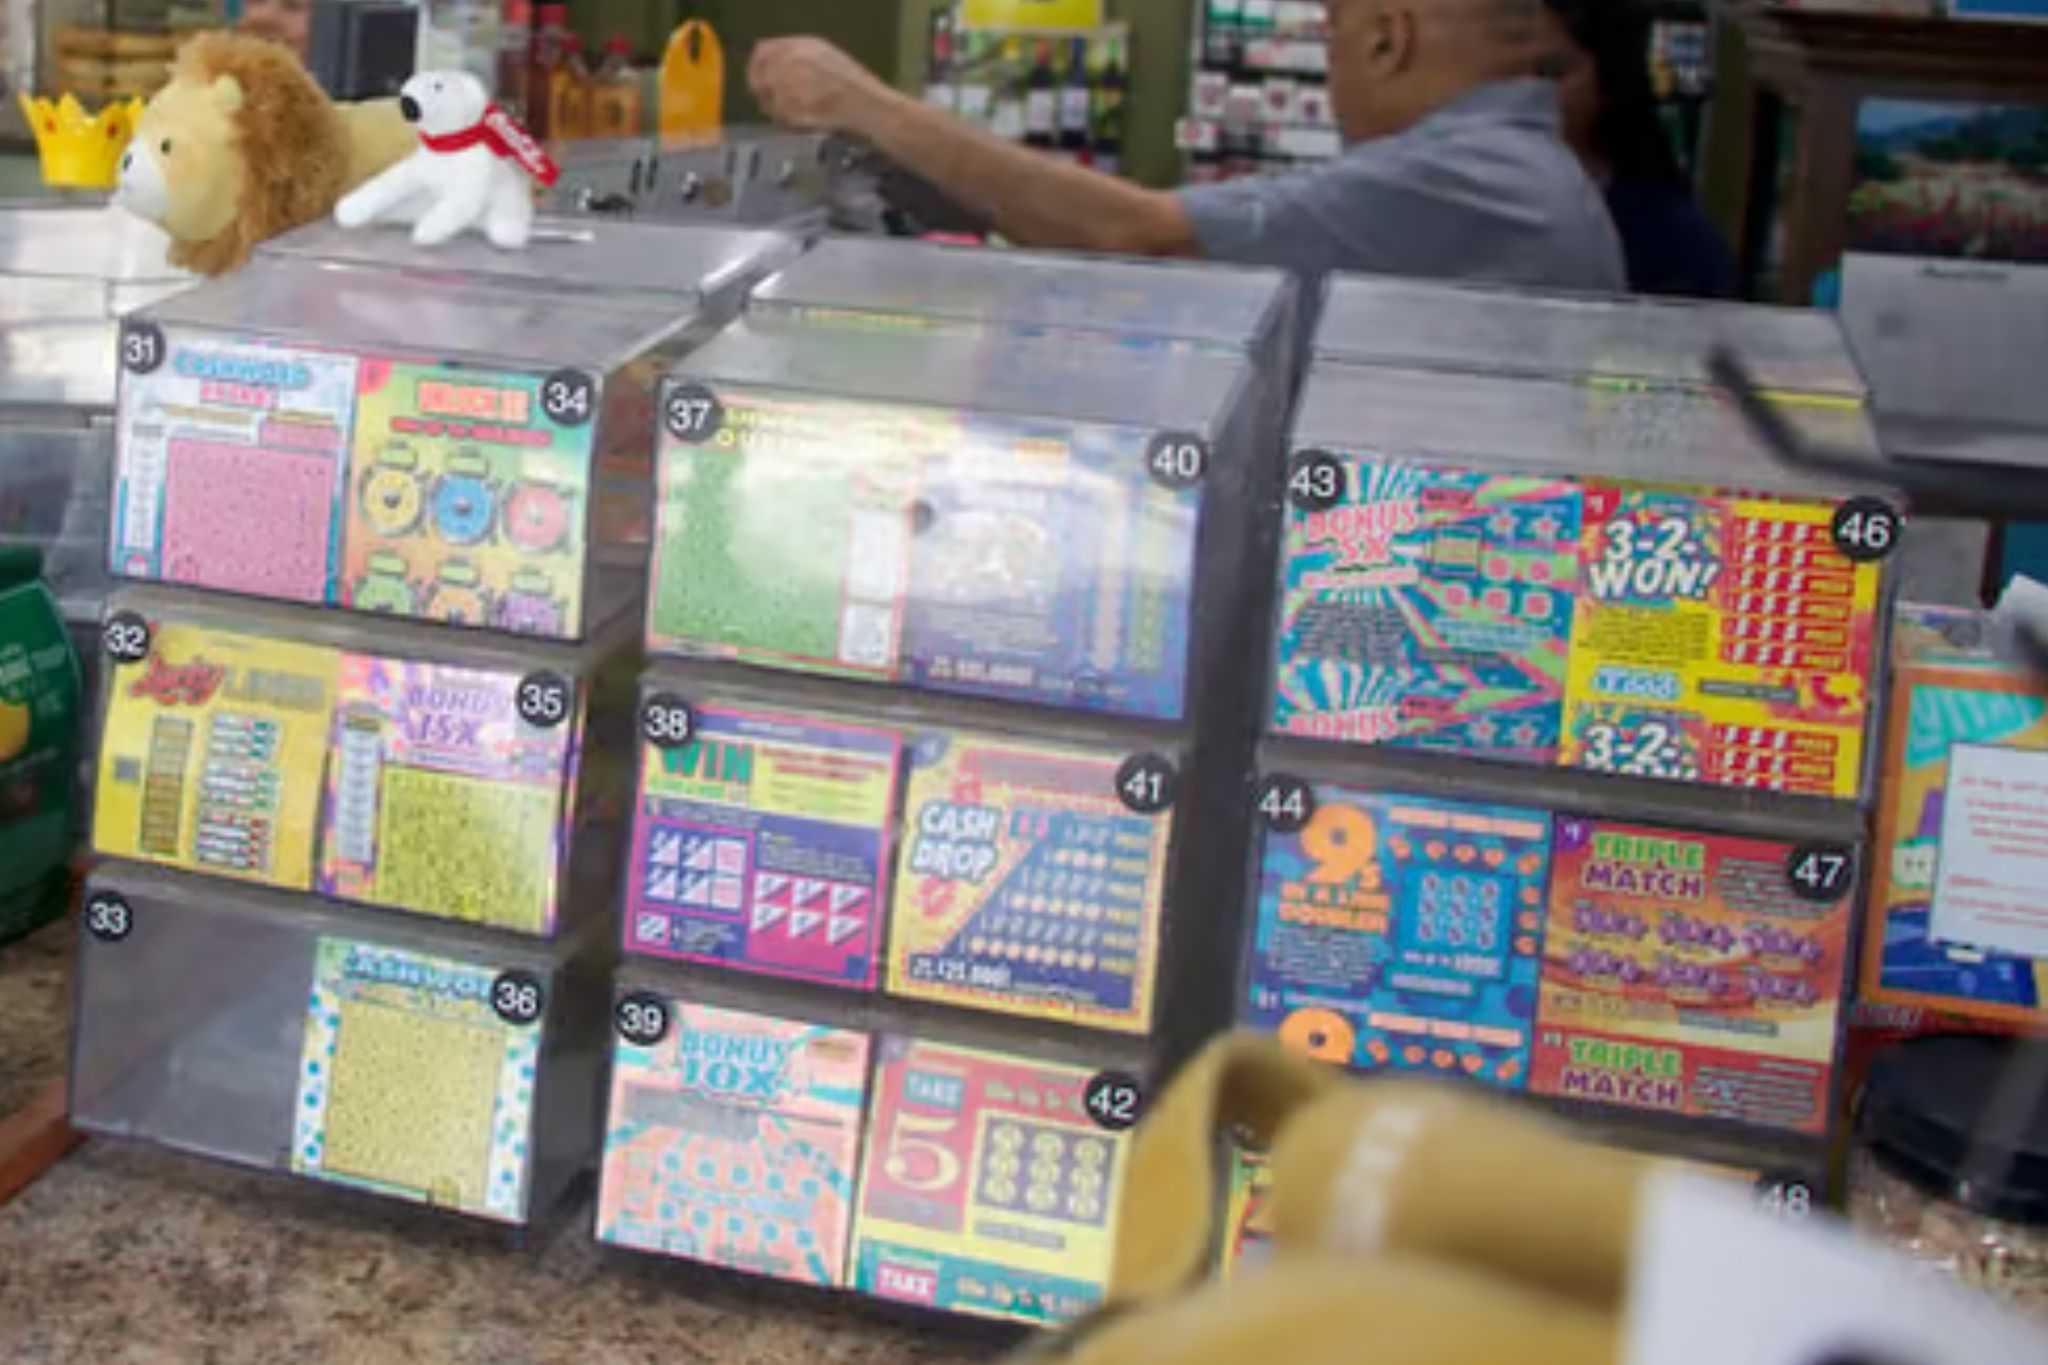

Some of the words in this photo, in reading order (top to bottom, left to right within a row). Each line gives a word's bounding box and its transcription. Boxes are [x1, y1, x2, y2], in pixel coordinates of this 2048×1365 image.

[126, 334, 156, 360] 31
[547, 381, 588, 414] 34
[669, 400, 711, 431] 37
[1153, 444, 1199, 476] 40
[1288, 464, 1337, 497] 43
[1306, 500, 1419, 543] BONUS
[1837, 511, 1890, 548] 46
[1605, 518, 1698, 561] 3-2-
[1589, 557, 1720, 600] WON!
[107, 624, 146, 655] 32
[521, 683, 563, 718] 35
[645, 705, 688, 740] 38
[661, 739, 755, 785] WIN
[1125, 769, 1161, 796] 41
[1259, 786, 1306, 821] 44
[920, 804, 997, 843] CASH
[911, 837, 997, 880] DROP
[1591, 831, 1704, 868] TRIPLE
[1582, 863, 1704, 899] MATCH
[1795, 854, 1846, 888] 47
[91, 901, 127, 934] 33
[496, 981, 538, 1016] 36
[621, 1003, 663, 1035] 39
[681, 1028, 787, 1066] BONUS
[1569, 1038, 1683, 1076] TRIPLE
[683, 1058, 779, 1098] 10X
[908, 1072, 961, 1107] TAKE
[1561, 1067, 1682, 1108] MATCH
[1088, 1084, 1136, 1121] 42
[883, 1111, 961, 1191] 5
[879, 1267, 932, 1297] TAKE
